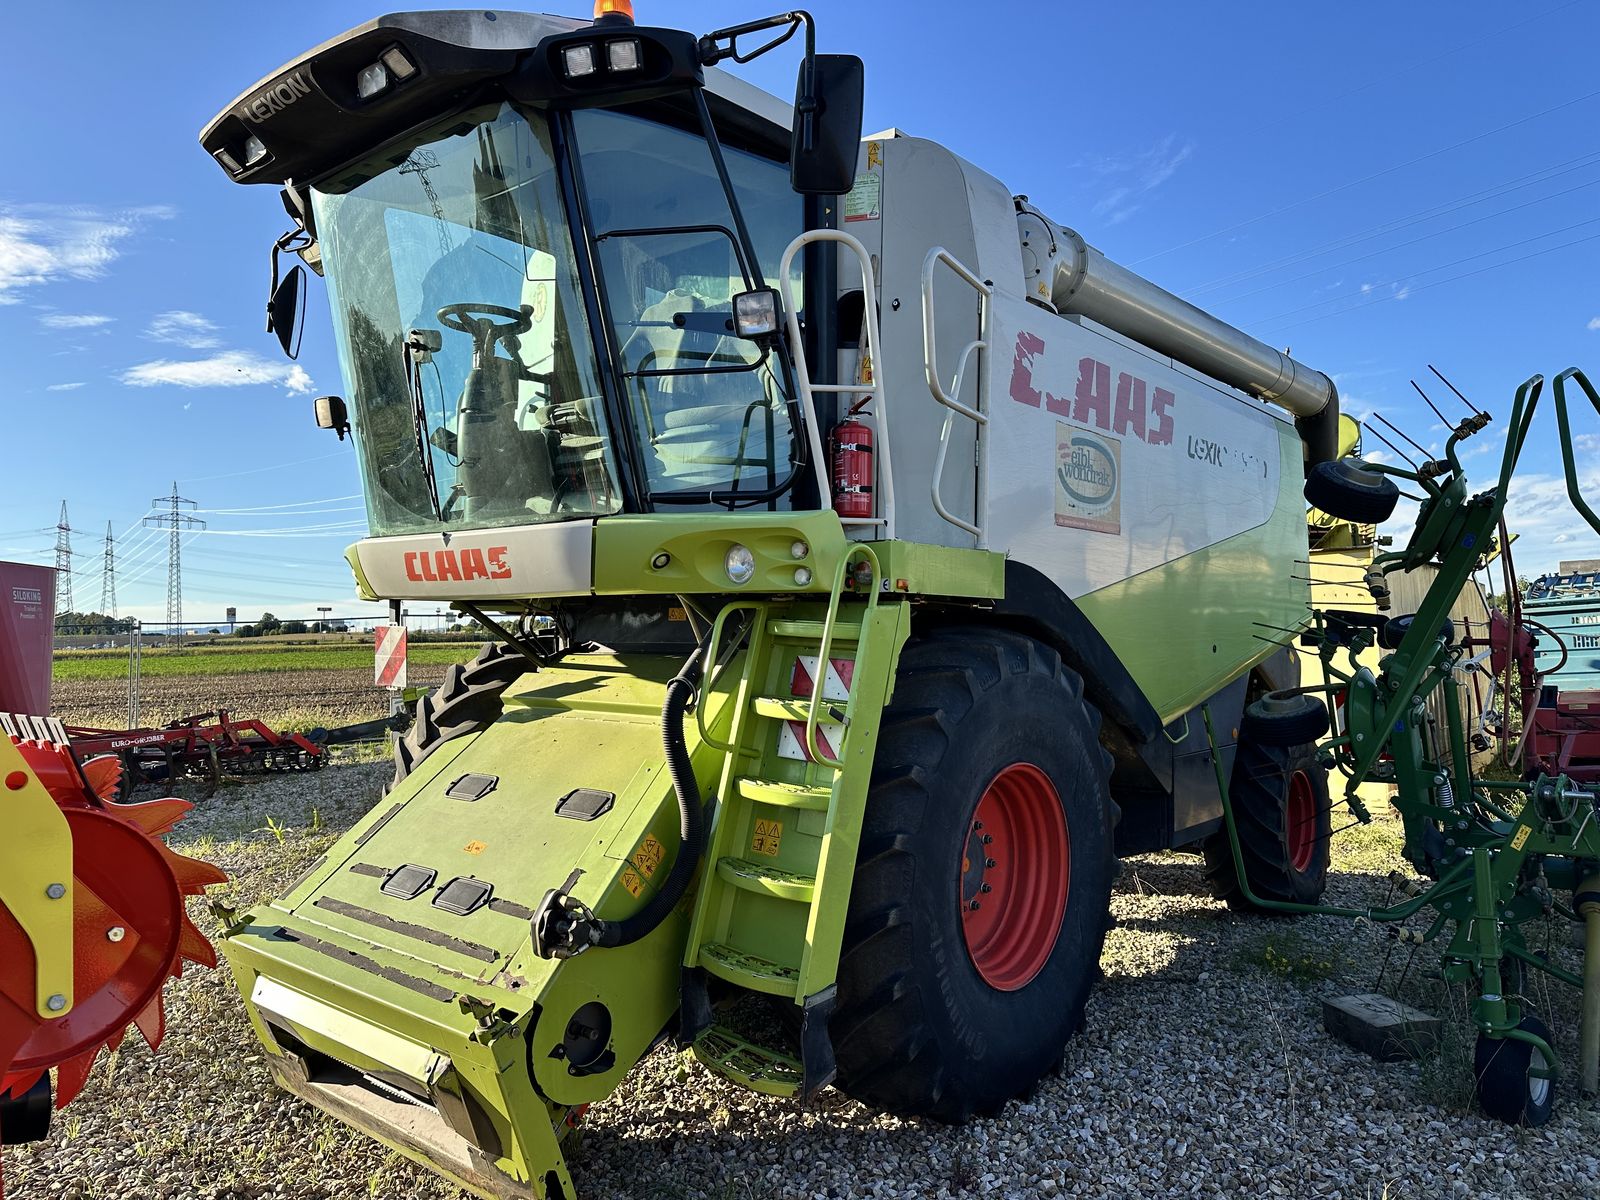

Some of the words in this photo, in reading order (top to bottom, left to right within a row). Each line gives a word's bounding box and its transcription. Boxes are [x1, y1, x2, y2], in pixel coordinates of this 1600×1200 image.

[243, 72, 312, 124] LEXION
[1071, 446, 1091, 469] eibl
[1063, 461, 1111, 487] wondrak
[403, 546, 513, 582] CLAAS
